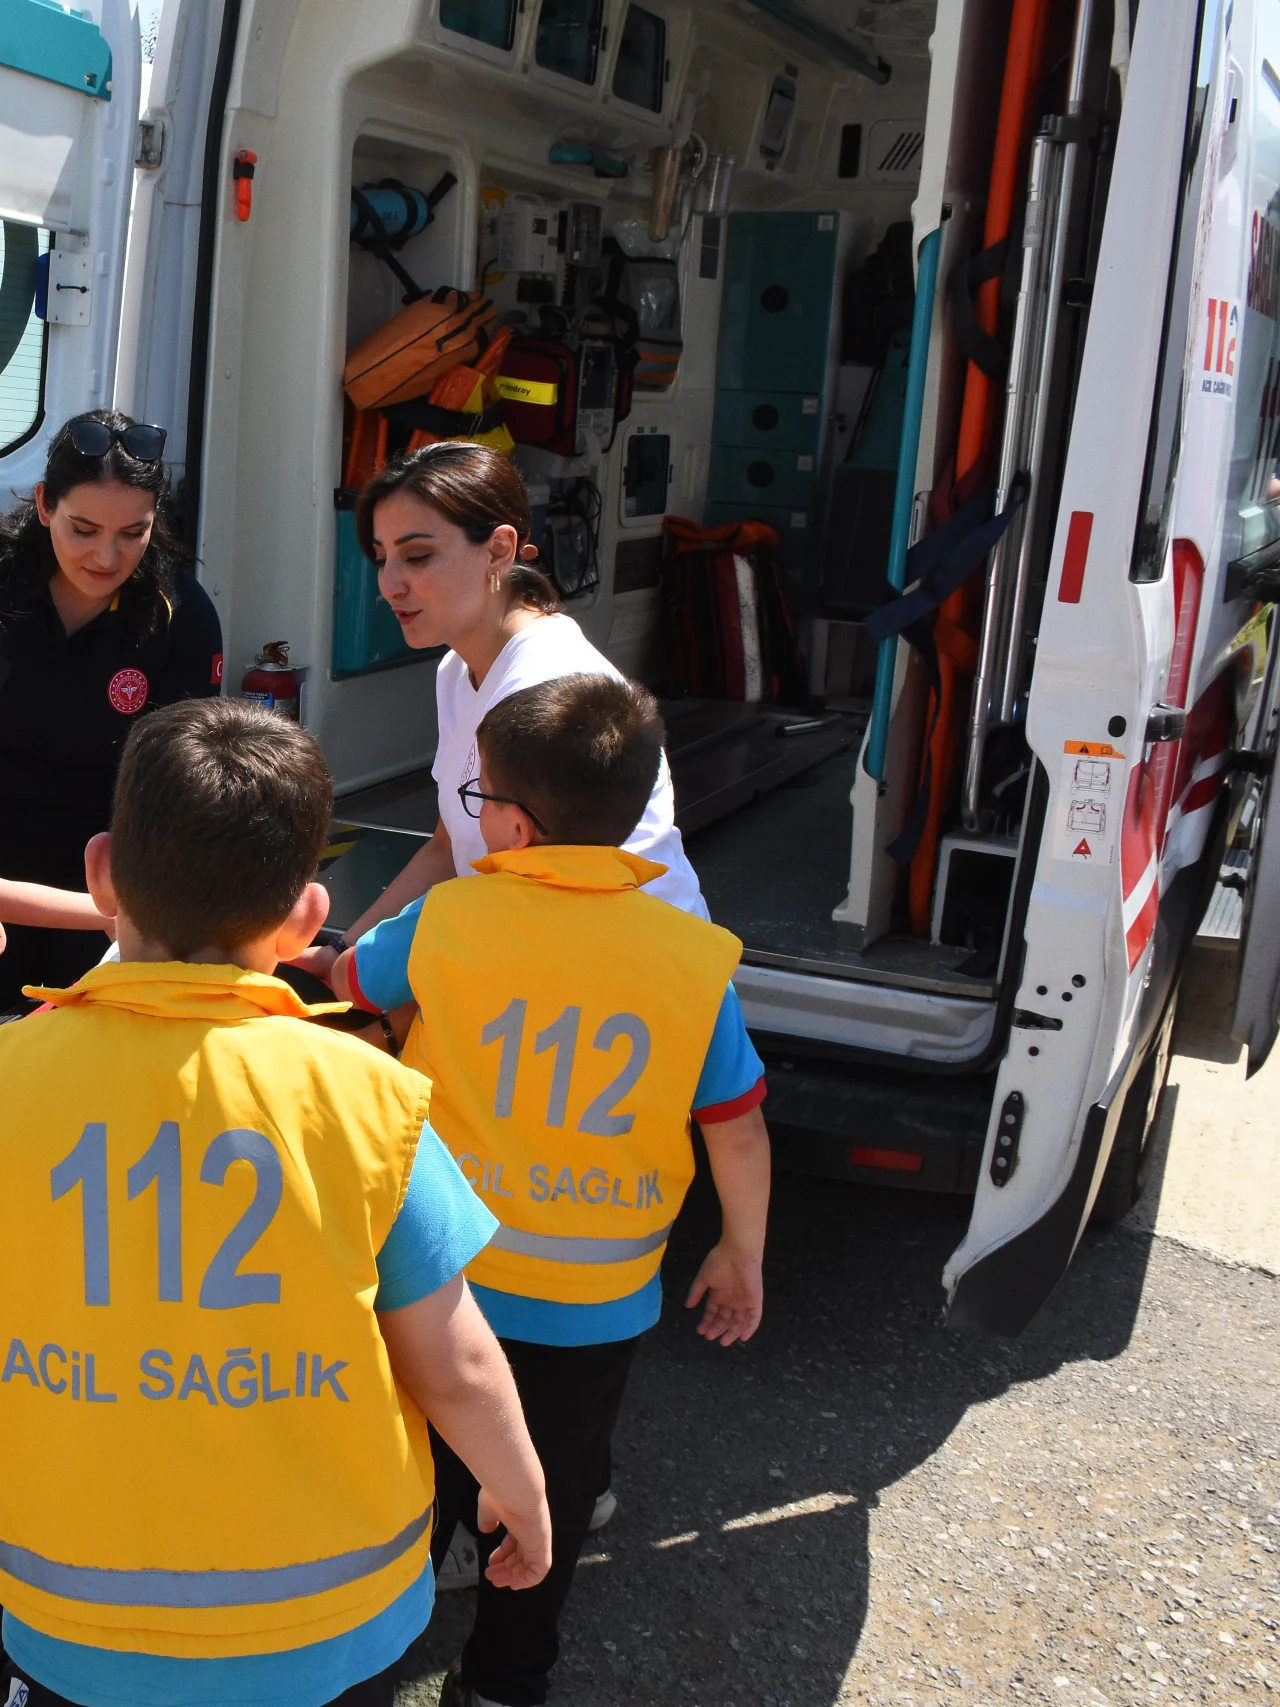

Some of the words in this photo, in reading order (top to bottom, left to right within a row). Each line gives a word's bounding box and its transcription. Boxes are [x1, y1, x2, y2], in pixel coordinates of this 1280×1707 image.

[480, 997, 652, 1138] 112
[50, 1121, 283, 1310] 112
[528, 1163, 664, 1210] SAĞLIK
[138, 1347, 350, 1409] SAĞLIK
